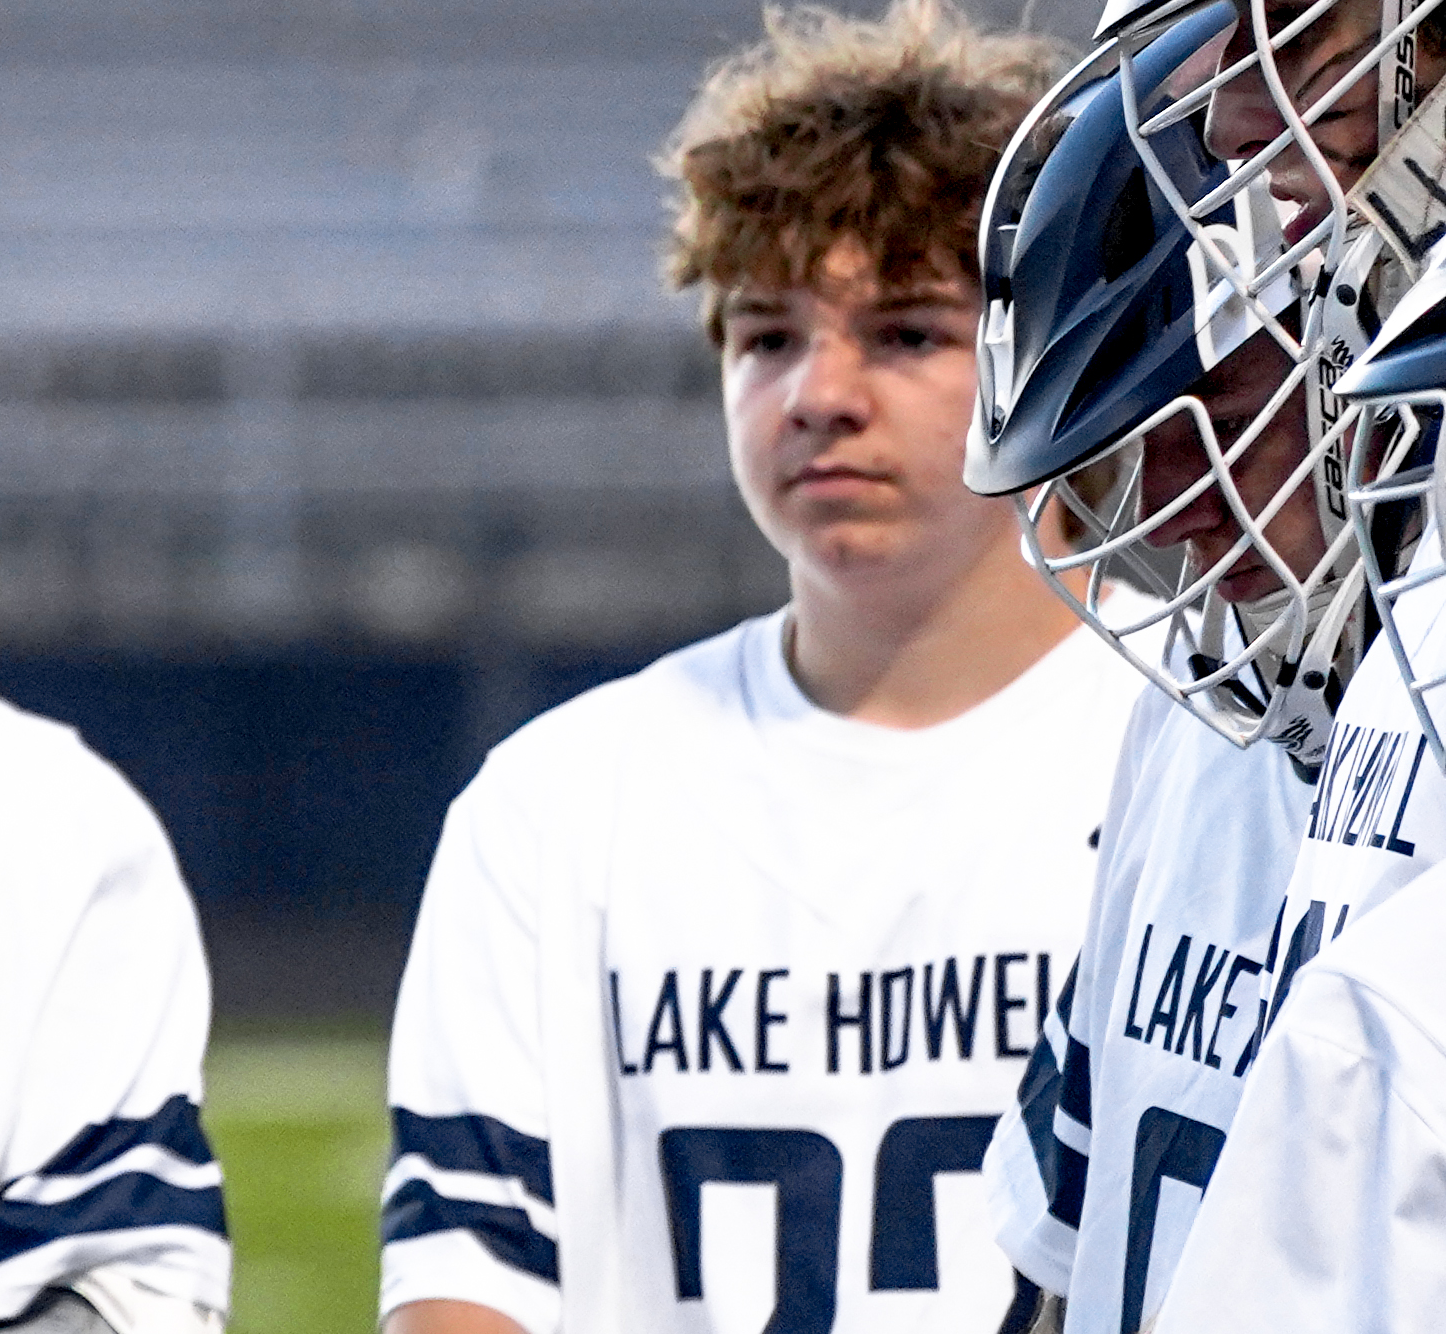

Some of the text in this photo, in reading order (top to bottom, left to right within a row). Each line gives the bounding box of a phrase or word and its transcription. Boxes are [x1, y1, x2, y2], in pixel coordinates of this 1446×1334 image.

[610, 951, 1053, 1075] LAKE HOWEL
[1123, 923, 1265, 1071] LAKE
